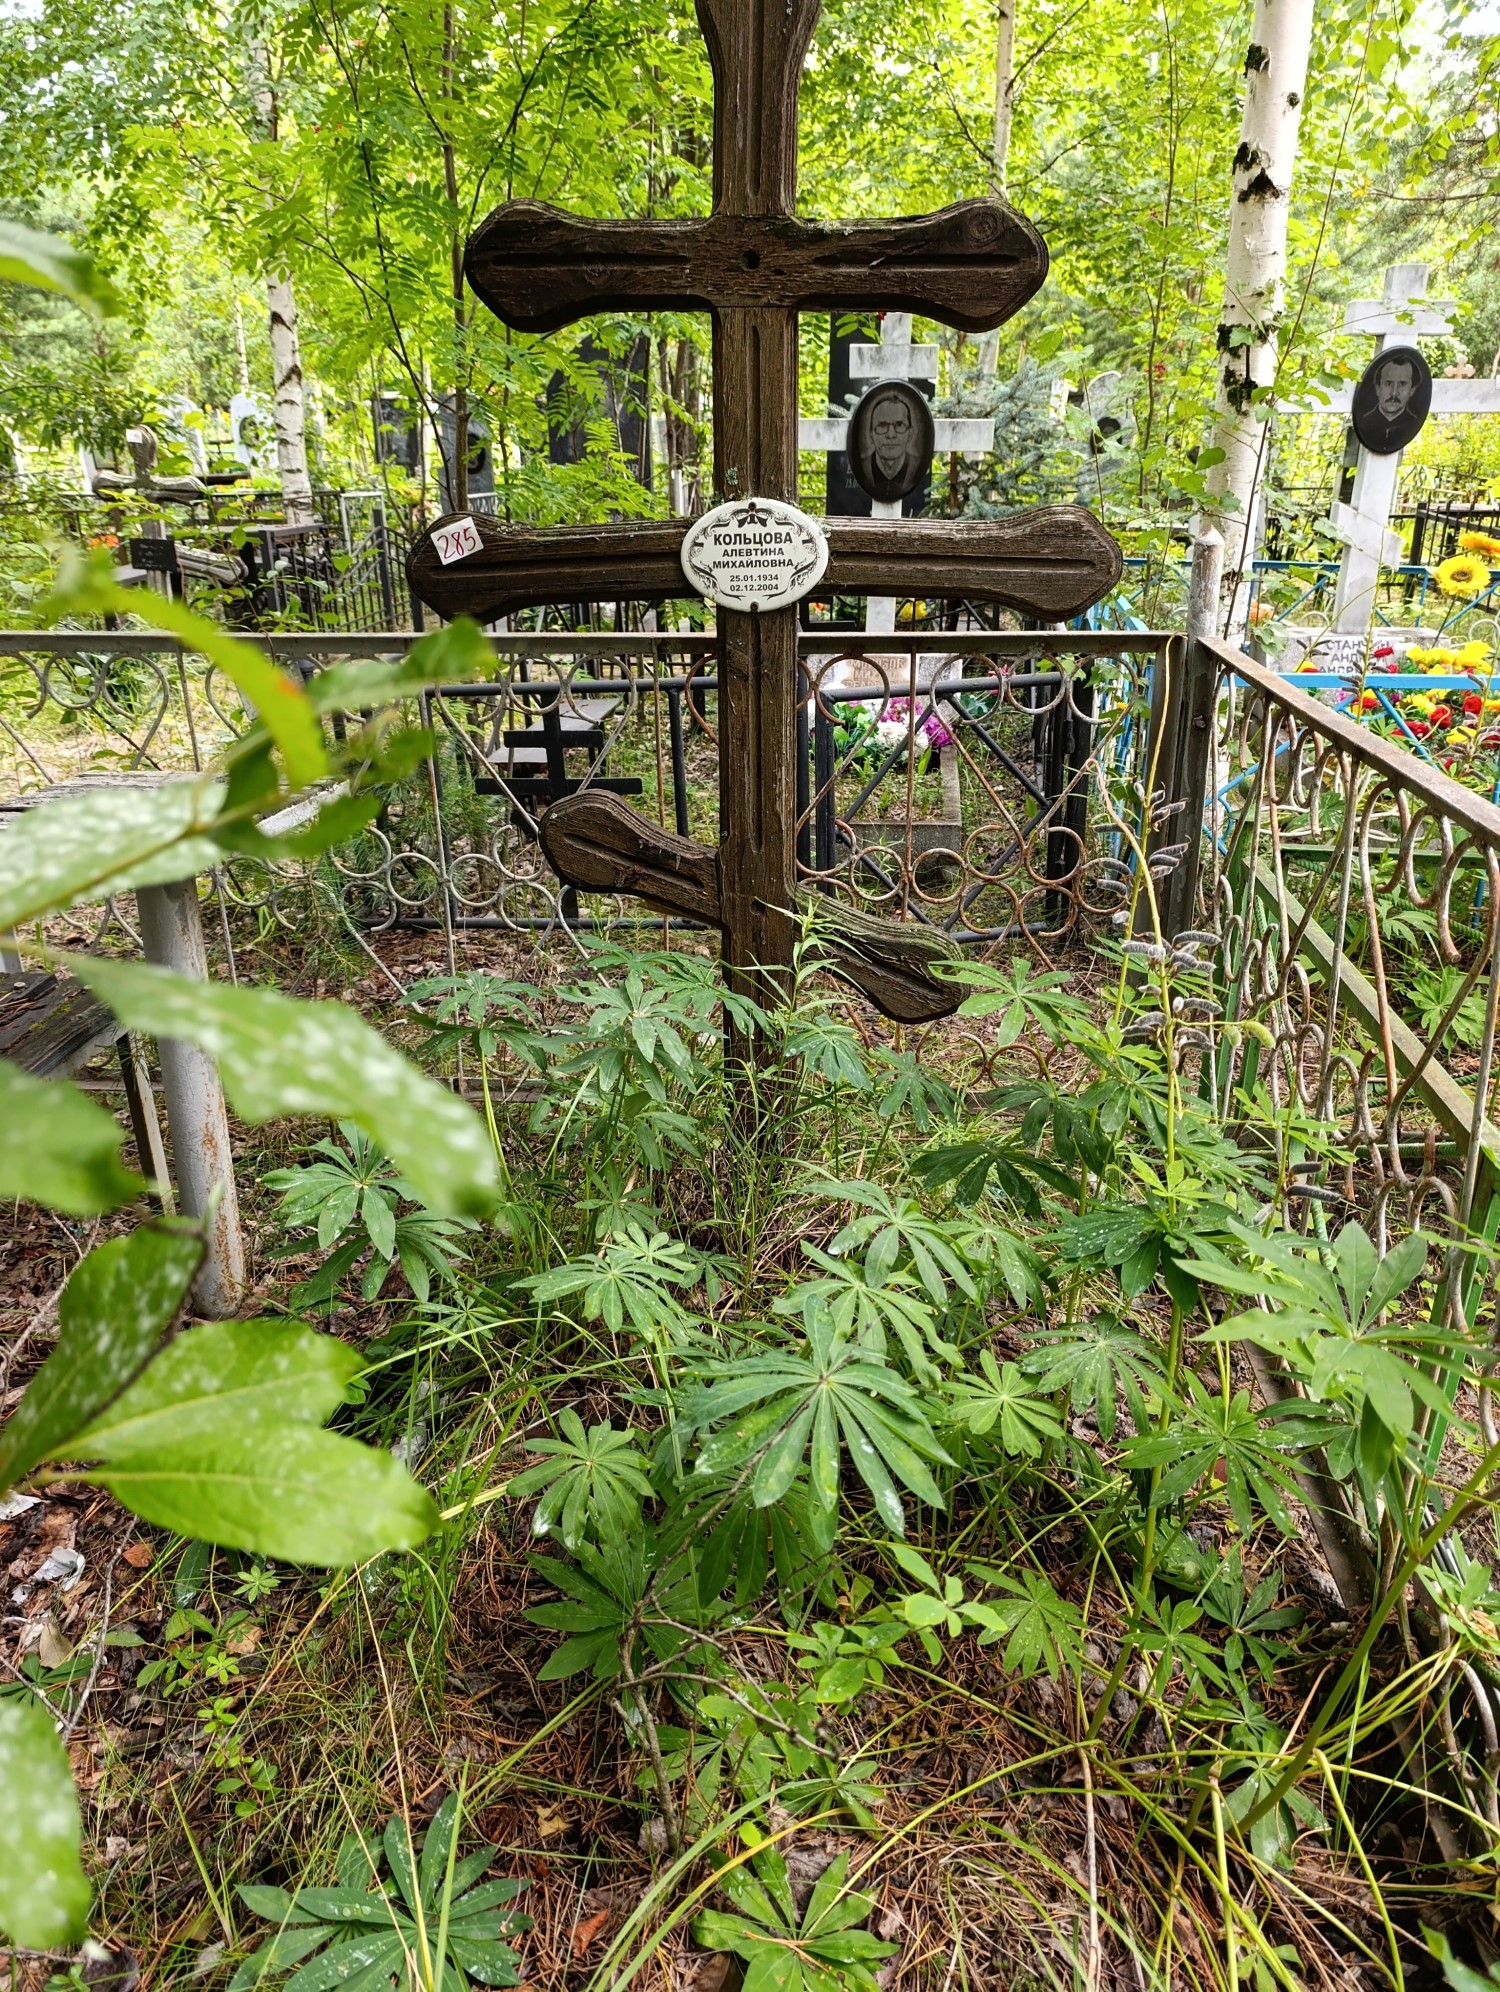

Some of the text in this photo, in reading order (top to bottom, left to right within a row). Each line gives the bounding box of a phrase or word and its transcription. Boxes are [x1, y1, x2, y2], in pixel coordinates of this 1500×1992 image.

[436, 526, 476, 559] 285
[713, 532, 793, 546] КОЛЬЦОВА
[722, 547, 785, 557] АЛЕВТИНА
[712, 558, 794, 569] МИХАЙЛОВНА
[729, 574, 779, 582] 25.01.1934
[729, 583, 779, 591] 02.12.2004
